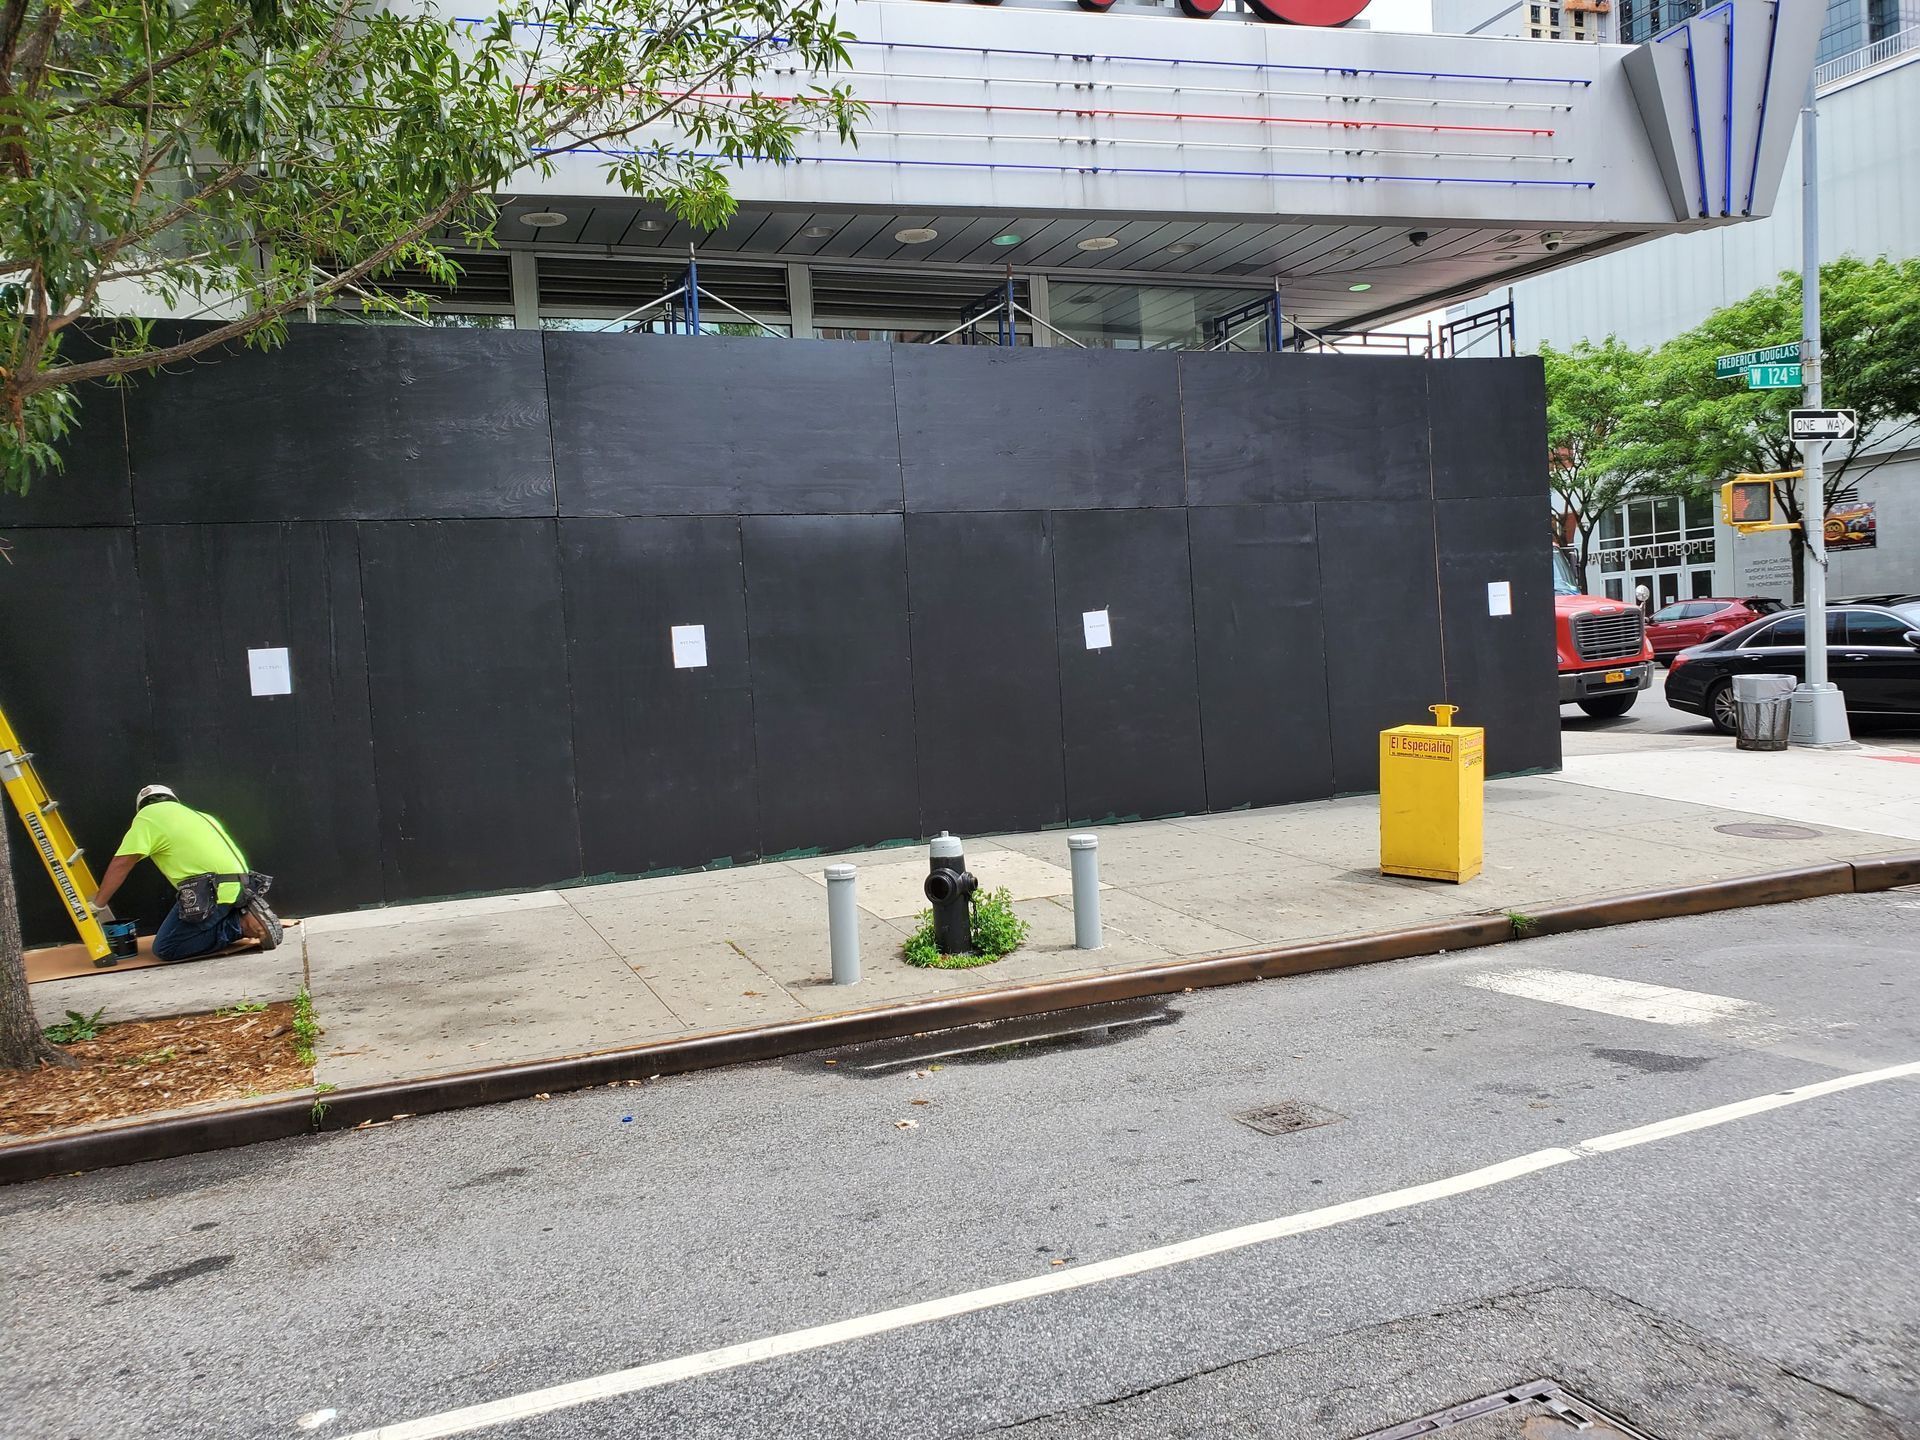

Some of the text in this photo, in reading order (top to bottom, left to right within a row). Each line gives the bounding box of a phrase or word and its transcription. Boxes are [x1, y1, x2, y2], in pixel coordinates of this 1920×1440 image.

[1718, 345, 1800, 370] FREDERICK DOUGLASS
[1751, 367, 1800, 385] W 124 ST
[1796, 419, 1846, 431] ONE WAY
[1587, 540, 1714, 566] RAYER FOR ALL PEOPLE
[1391, 737, 1399, 749] El
[1402, 738, 1451, 754] Especialito
[26, 812, 45, 838] LITTLE
[40, 837, 58, 864] GIANT
[54, 864, 85, 913] FIBERGLASS
